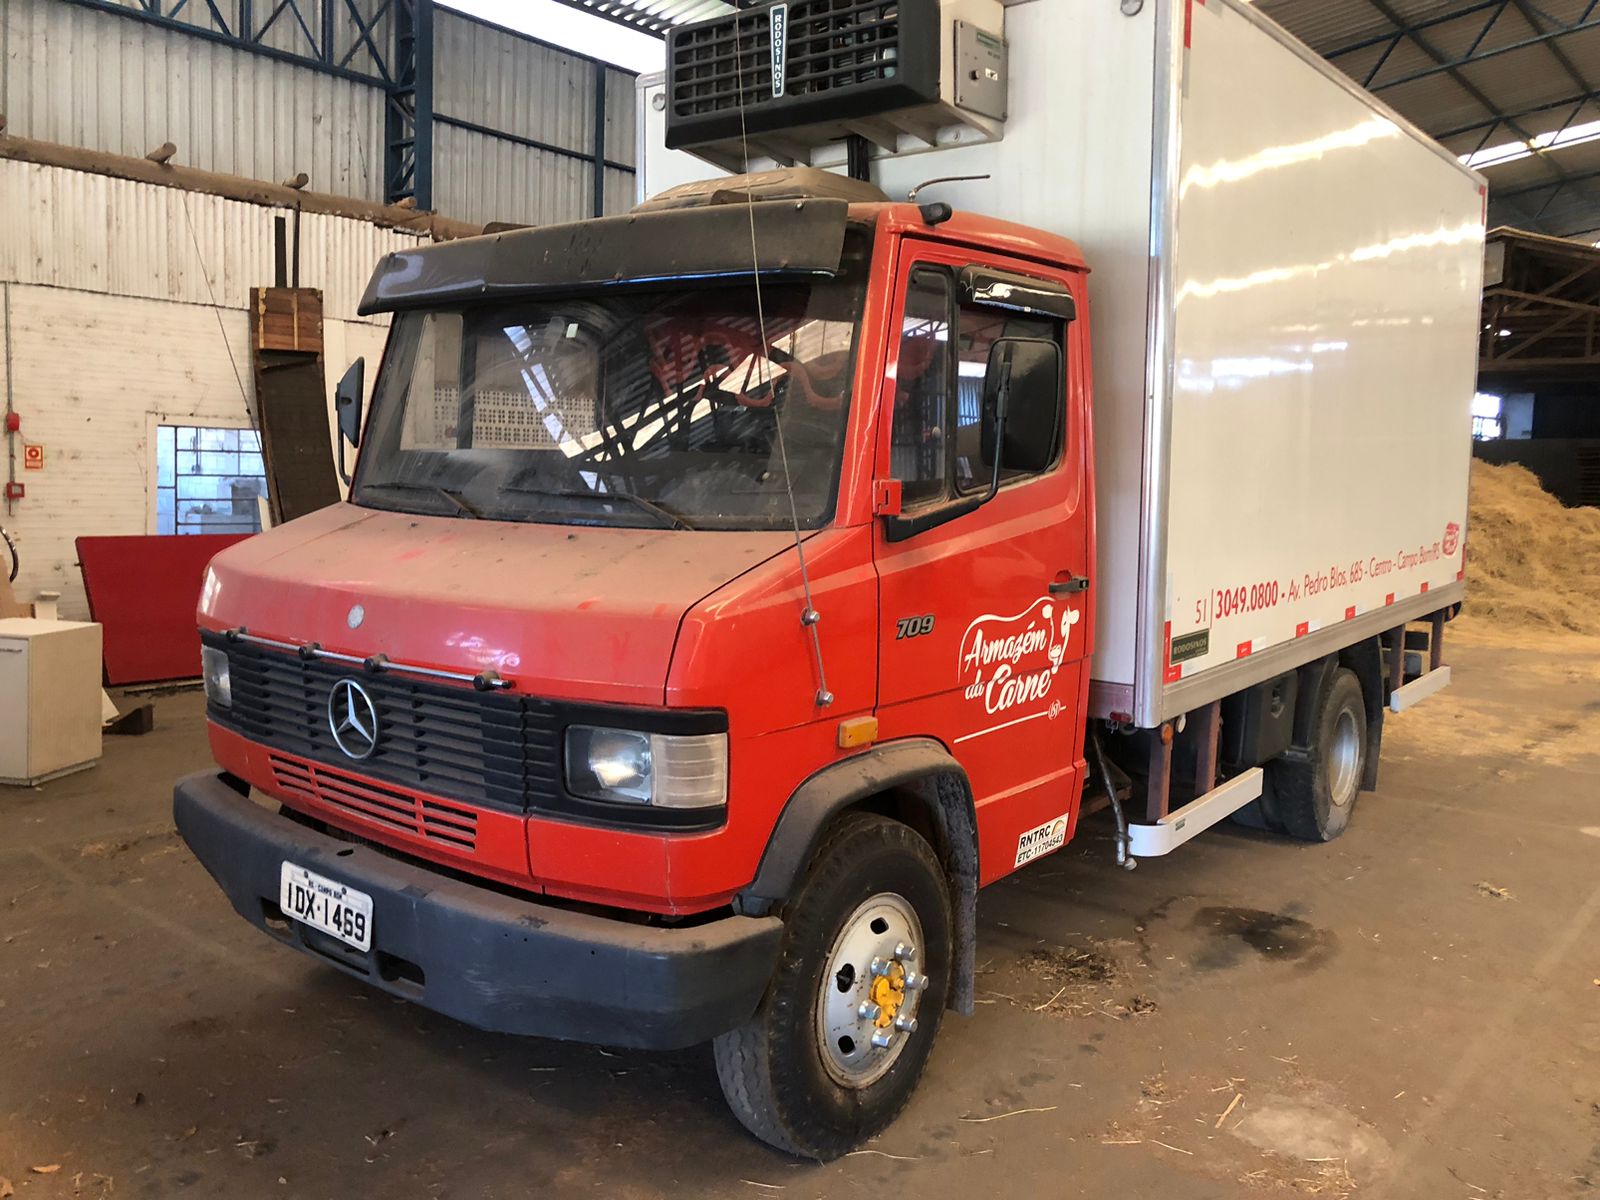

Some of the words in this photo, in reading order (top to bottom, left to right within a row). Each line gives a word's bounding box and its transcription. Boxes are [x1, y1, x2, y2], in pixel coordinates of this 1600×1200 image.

[774, 14, 783, 88] RODOSINOS
[1195, 599, 1207, 624] 51
[1215, 580, 1279, 619] 3049.0800
[1288, 578, 1301, 603] Av.
[1303, 570, 1328, 597] Pedro
[1350, 560, 1363, 584] 685
[1369, 556, 1392, 578] Centro
[1397, 550, 1418, 571] Campo
[896, 614, 935, 640] 709
[964, 620, 1047, 673] Armazém
[965, 669, 985, 700] da
[985, 663, 1052, 714] Carne
[1019, 825, 1051, 848] RNTRC
